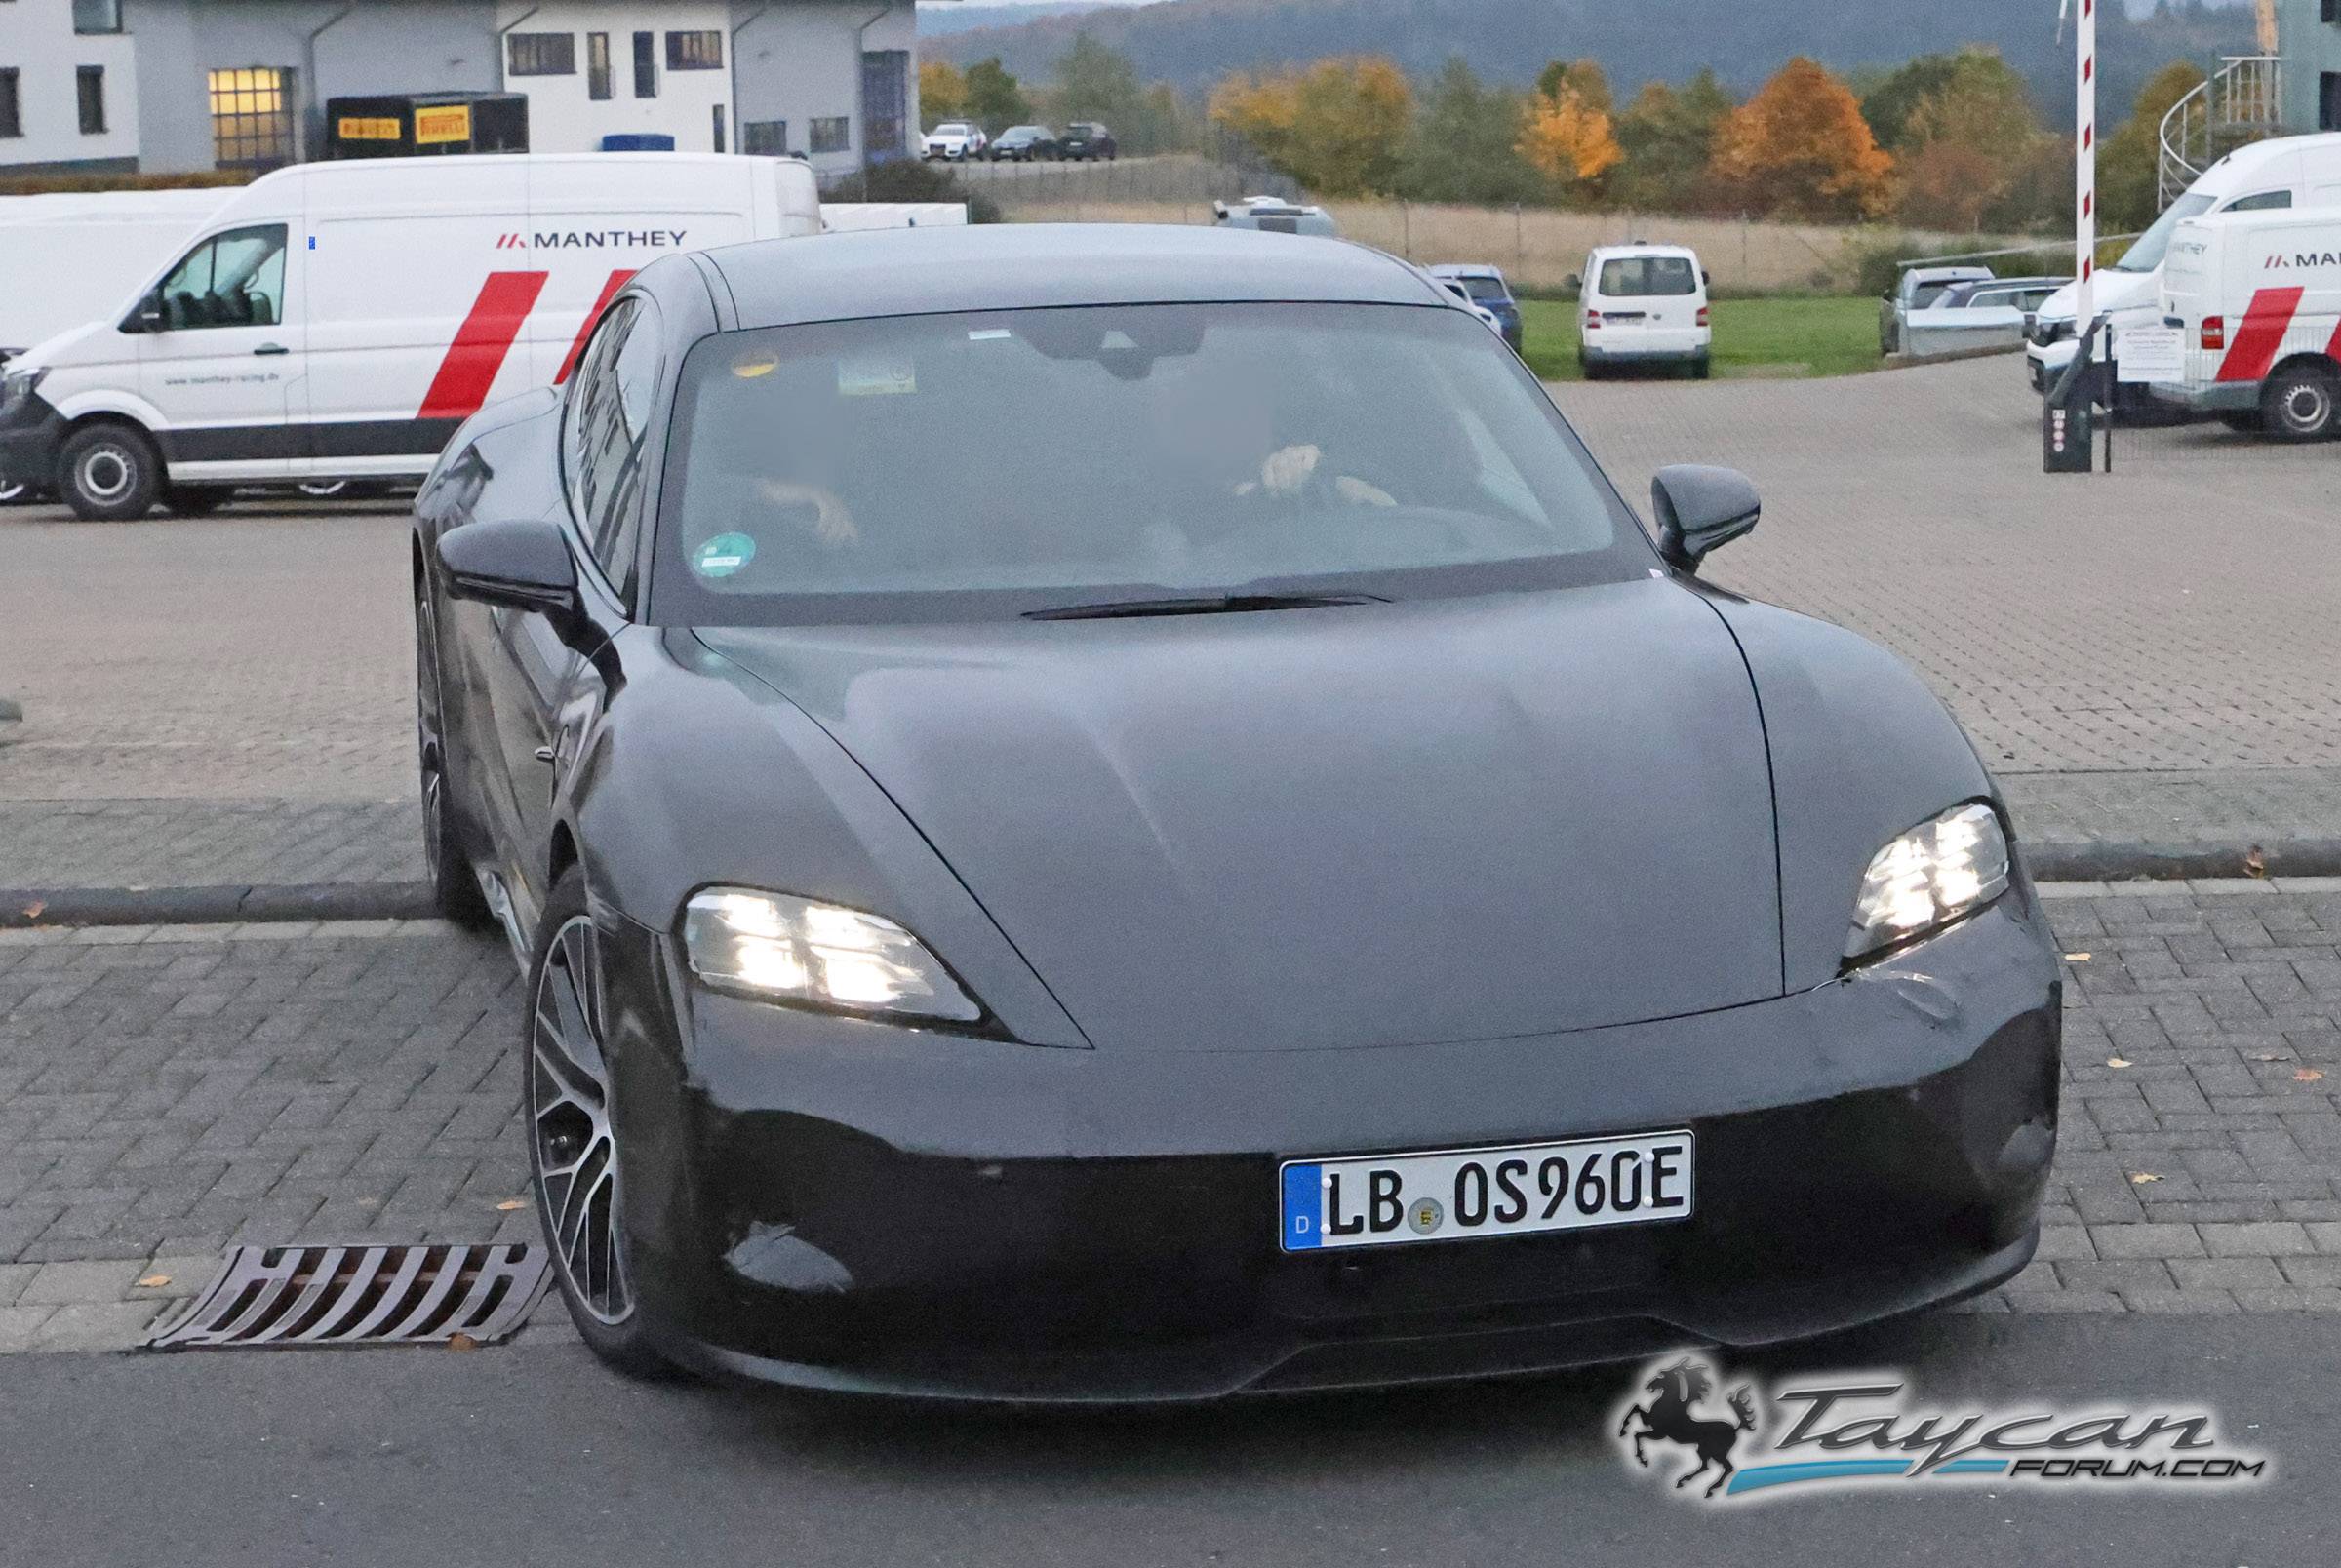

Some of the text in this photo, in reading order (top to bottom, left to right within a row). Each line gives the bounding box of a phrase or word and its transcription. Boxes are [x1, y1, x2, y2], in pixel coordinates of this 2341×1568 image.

[535, 230, 687, 248] MANTHEY
[2296, 252, 2341, 267] MA
[1329, 1169, 1405, 1235] LB
[1294, 1215, 1309, 1235] D
